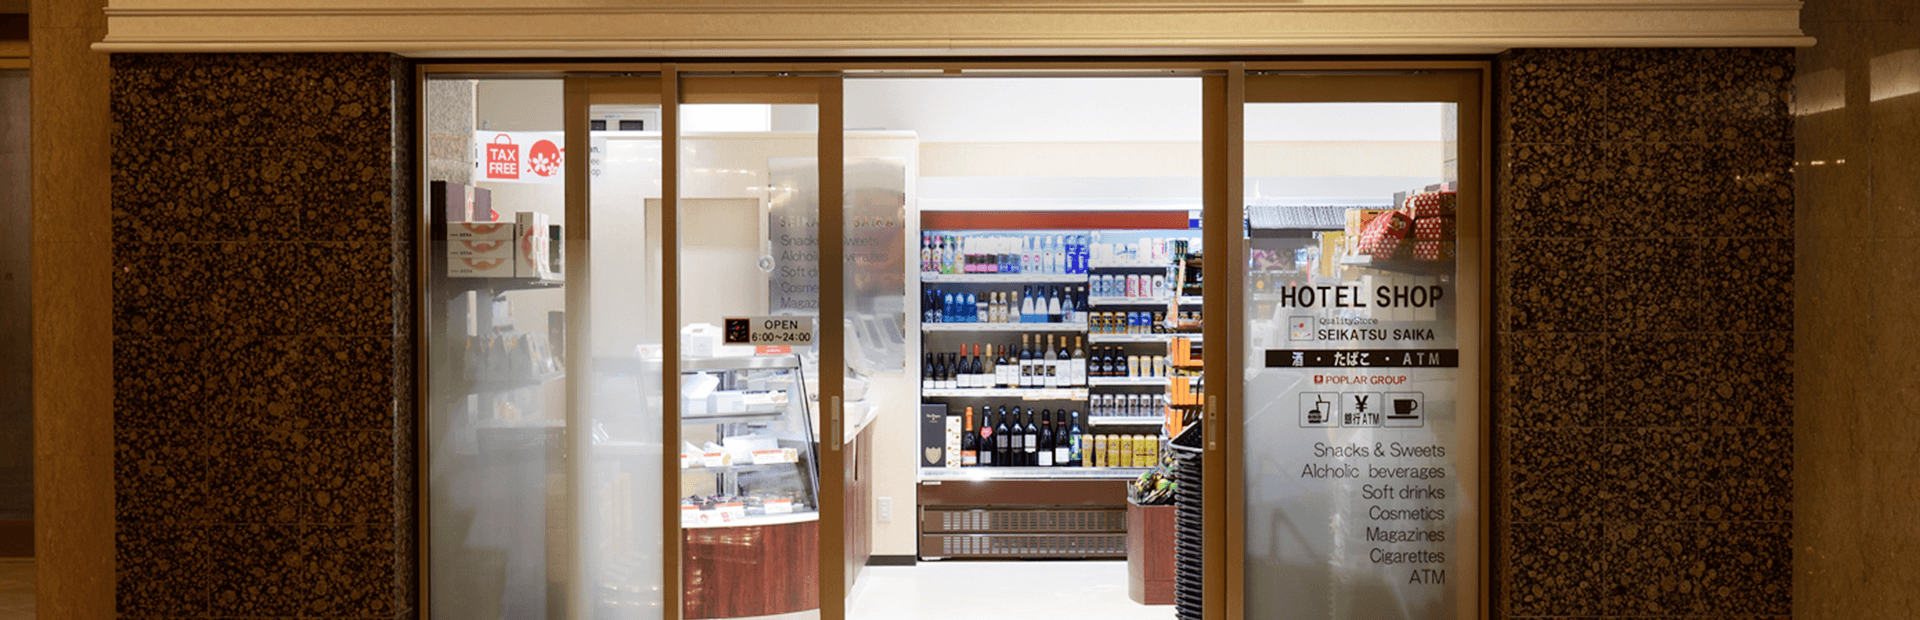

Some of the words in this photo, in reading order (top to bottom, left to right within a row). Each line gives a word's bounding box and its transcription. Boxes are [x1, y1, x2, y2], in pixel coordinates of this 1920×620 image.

[489, 148, 516, 161] TAX
[489, 162, 517, 175] FREE
[781, 266, 806, 278] Soft
[781, 282, 818, 294] Cosme
[781, 297, 818, 310] Magaz
[1281, 286, 1367, 308] HOTEL
[1376, 286, 1444, 308] SHOP
[764, 320, 798, 330] OPEN
[1318, 329, 1388, 341] SEIKATSU
[1393, 329, 1435, 341] SAIKA
[1292, 352, 1304, 366] 酒
[1334, 352, 1370, 366] たばこ
[1326, 376, 1367, 384] POPLAR
[1370, 376, 1407, 384] GROUP
[1314, 442, 1369, 457] Snacks
[1373, 442, 1386, 457] &
[1390, 442, 1446, 457] Sweets
[1301, 463, 1359, 478] Alcholic
[1369, 464, 1446, 480] beverages
[1362, 484, 1394, 499] Soft
[1399, 484, 1446, 499] drinks
[1368, 505, 1446, 520] Cosmetics
[1366, 526, 1446, 543] Magazines
[1369, 548, 1446, 565] Cigarettes
[1409, 569, 1446, 584] ATM
